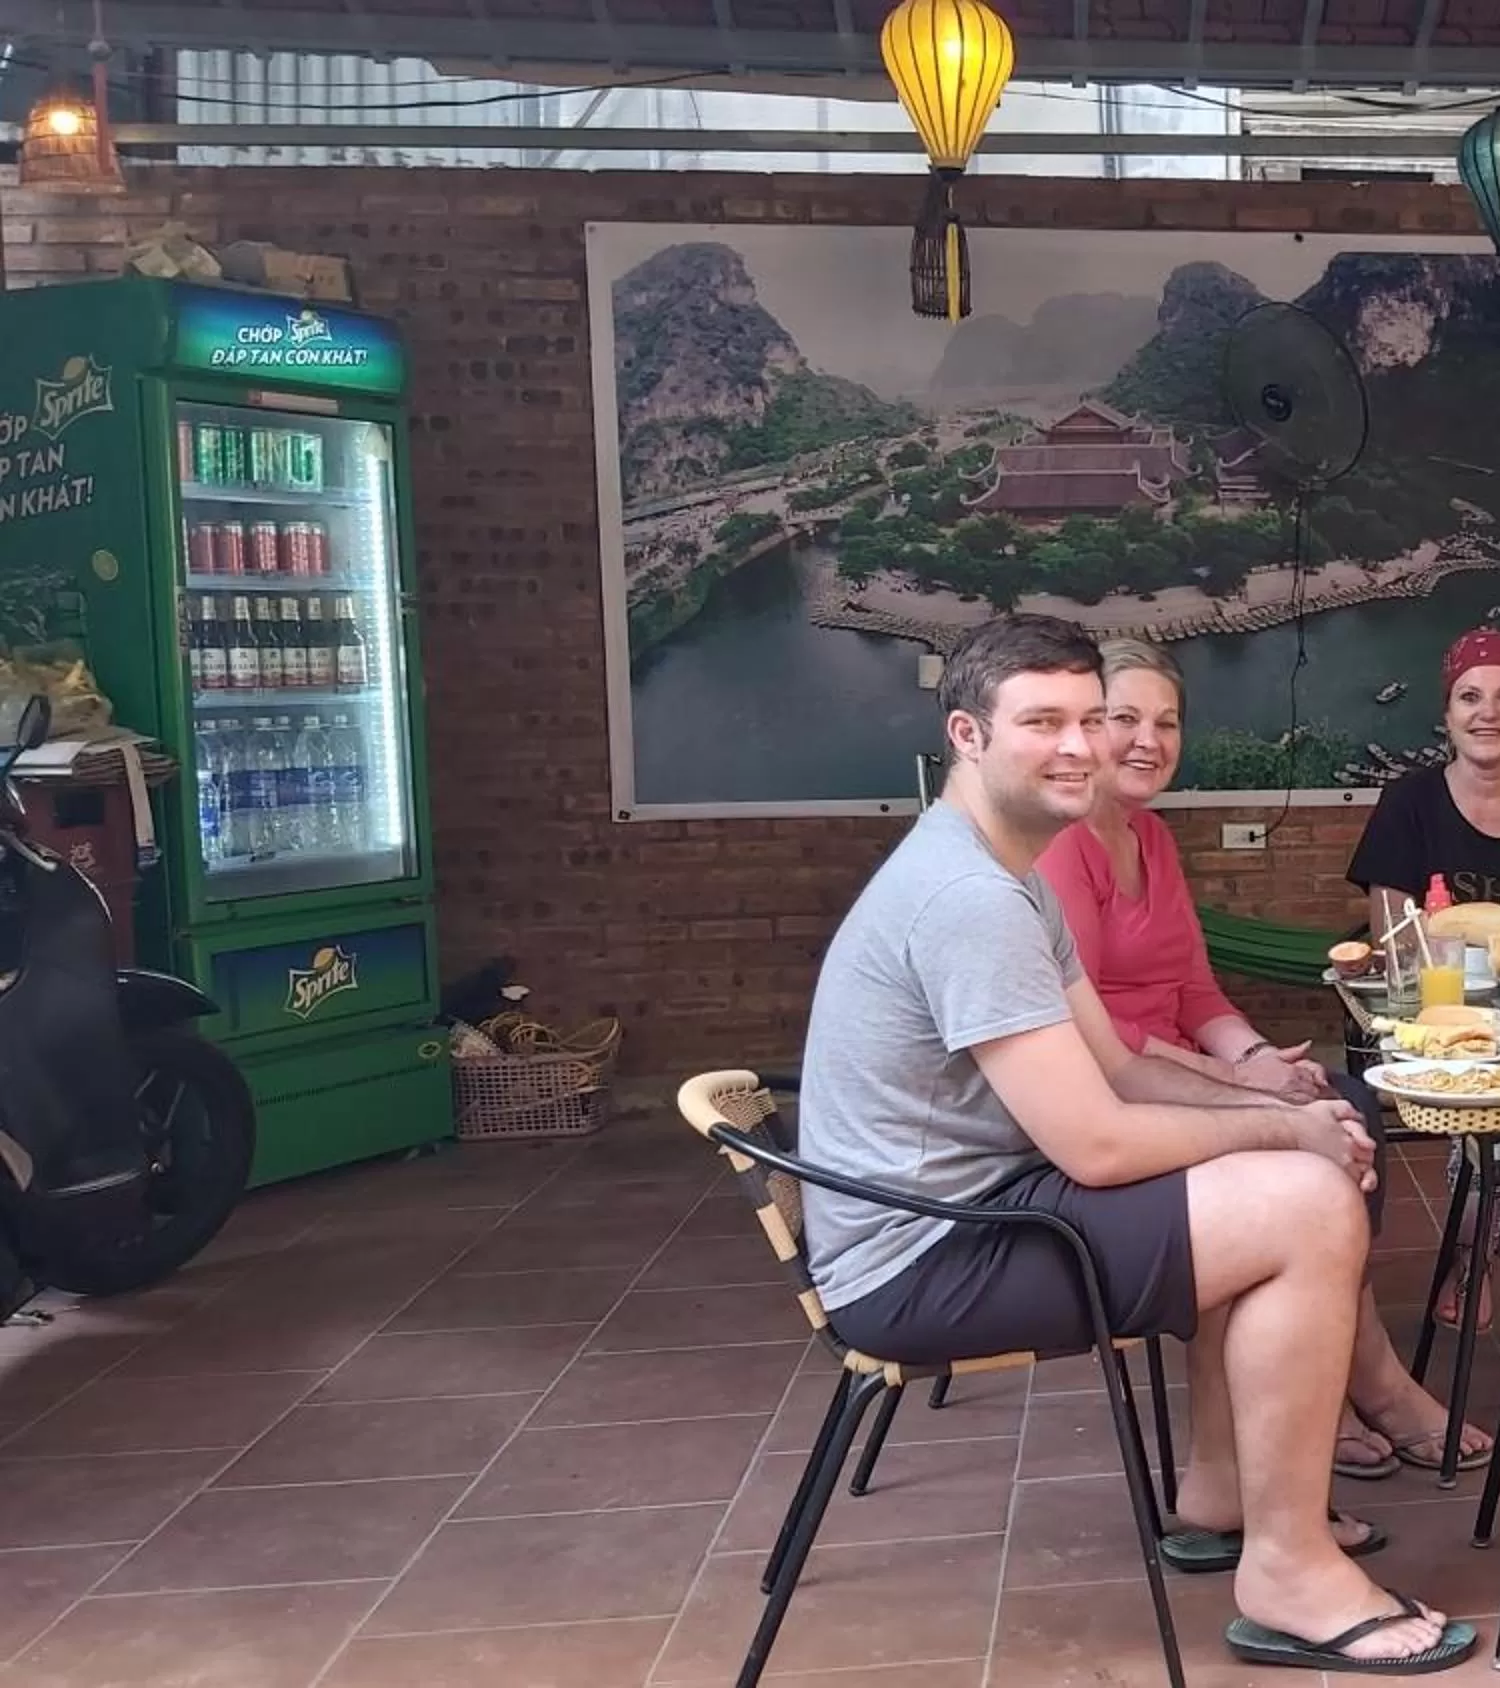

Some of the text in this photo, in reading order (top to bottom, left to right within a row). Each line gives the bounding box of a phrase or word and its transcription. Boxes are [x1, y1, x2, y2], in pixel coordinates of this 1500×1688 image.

[249, 349, 283, 365] TAN
[40, 369, 105, 428] Sprite
[16, 443, 65, 480] TAN
[293, 955, 349, 1009] Sprite
